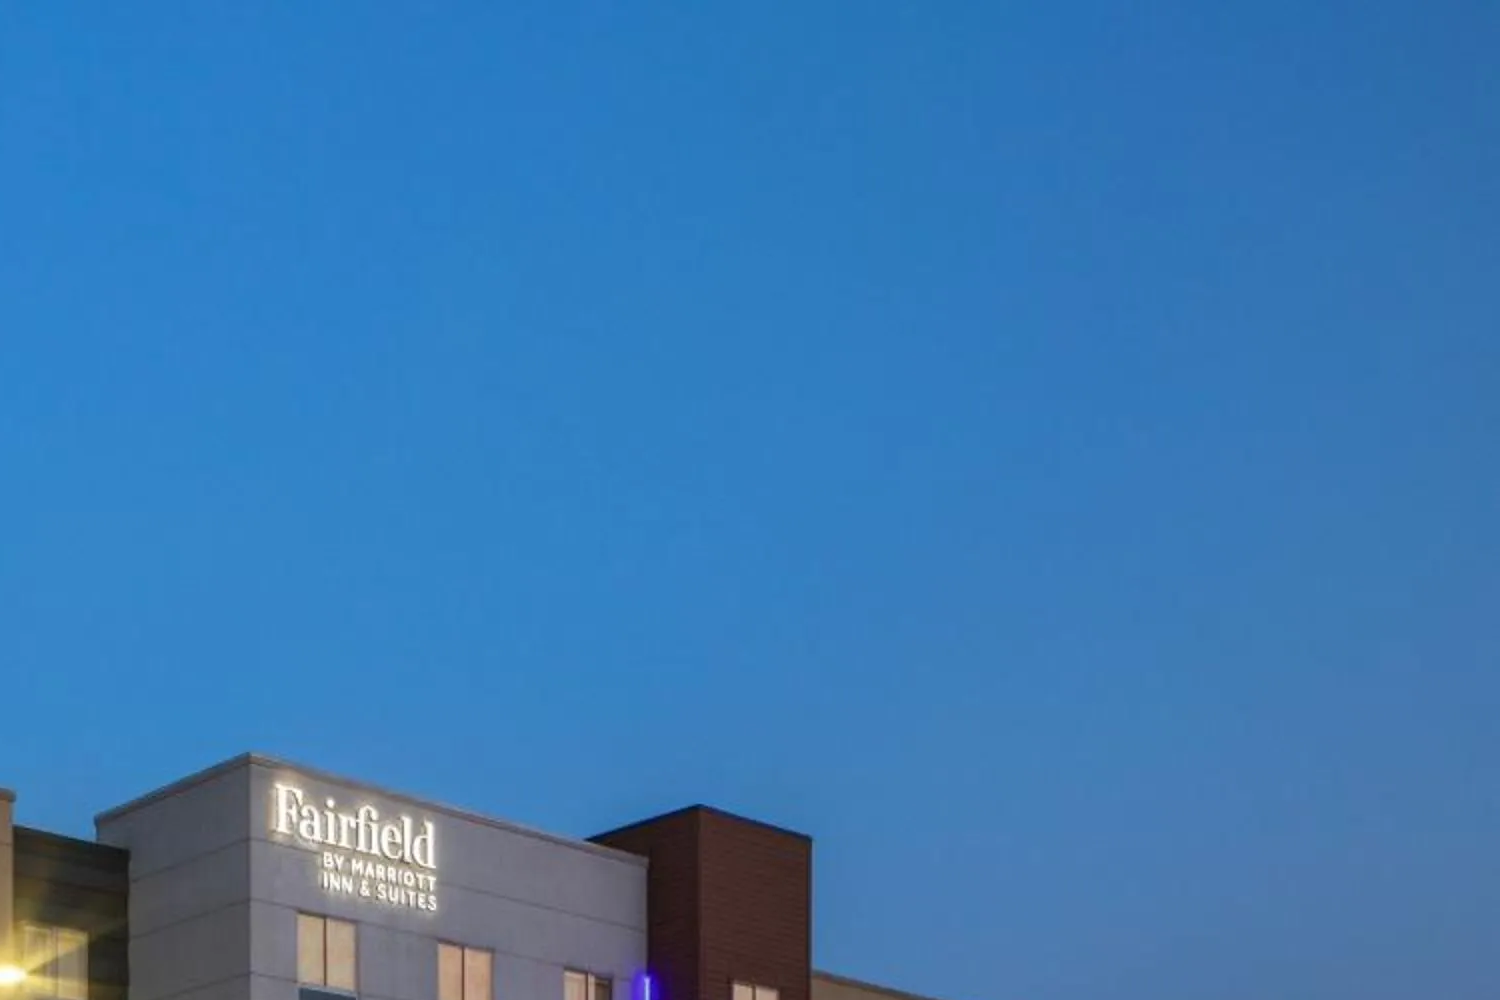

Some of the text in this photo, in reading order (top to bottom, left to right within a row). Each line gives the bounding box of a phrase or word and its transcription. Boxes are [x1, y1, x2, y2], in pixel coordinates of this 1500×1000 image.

[274, 782, 437, 869] Fairfield
[323, 852, 437, 892] BY MARRIOTT
[323, 871, 437, 912] INN & SUITES
